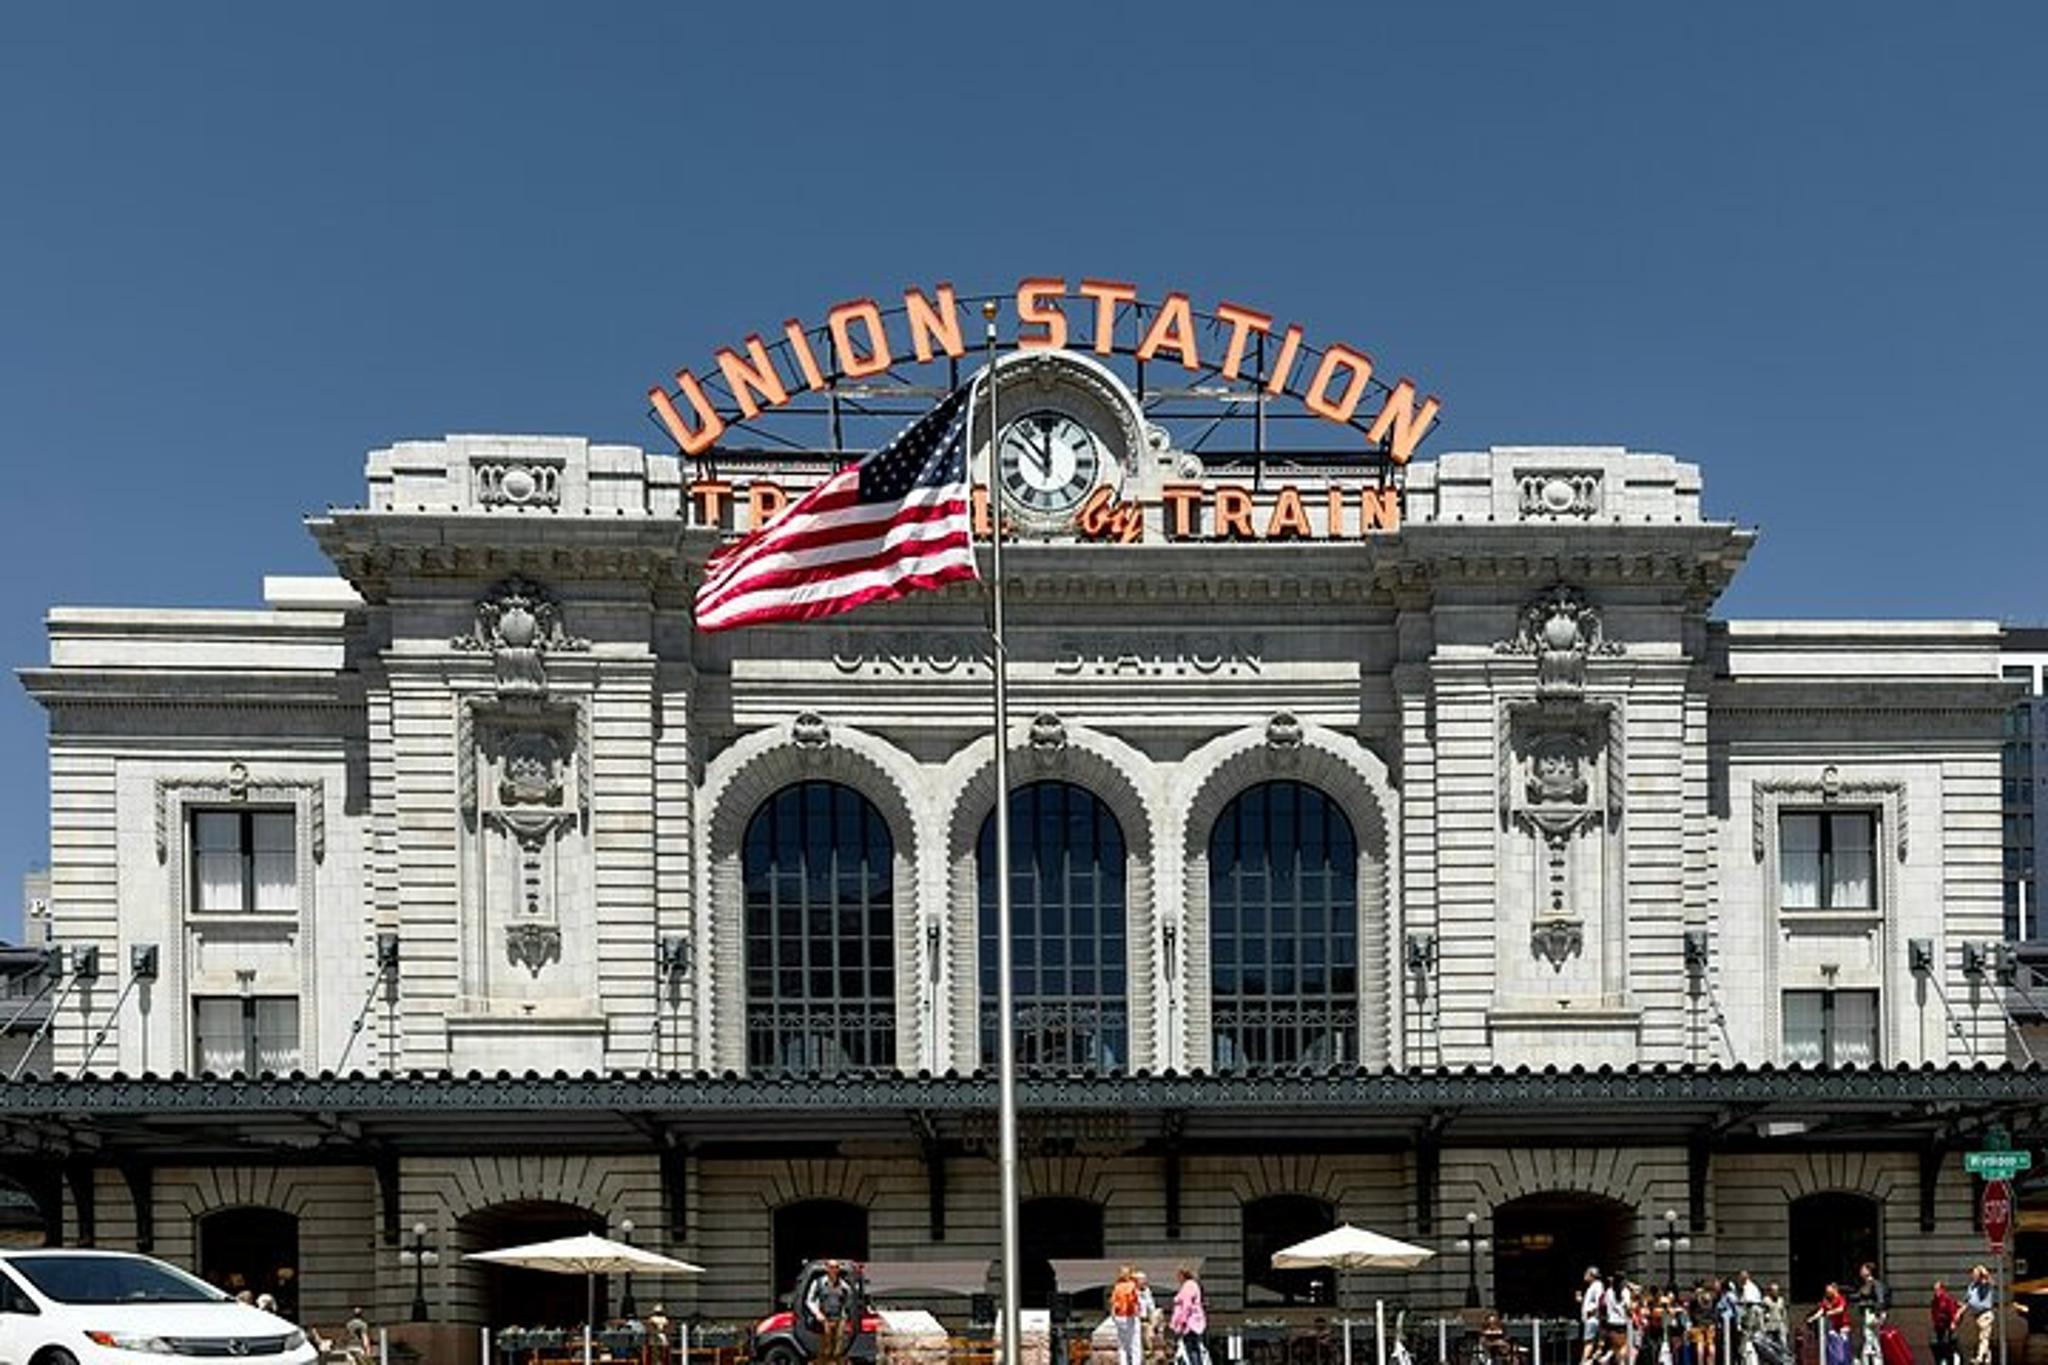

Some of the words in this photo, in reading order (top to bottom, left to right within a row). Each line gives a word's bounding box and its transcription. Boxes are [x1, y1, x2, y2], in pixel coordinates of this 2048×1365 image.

[648, 282, 966, 456] UNION
[1016, 277, 1440, 464] STATION
[688, 480, 1014, 543] TRL
[1074, 483, 1144, 544] by
[1163, 484, 1400, 541] TRAIN
[830, 634, 1005, 675] UNION
[1055, 634, 1268, 675] STATION
[1984, 1200, 2010, 1224] STOP
